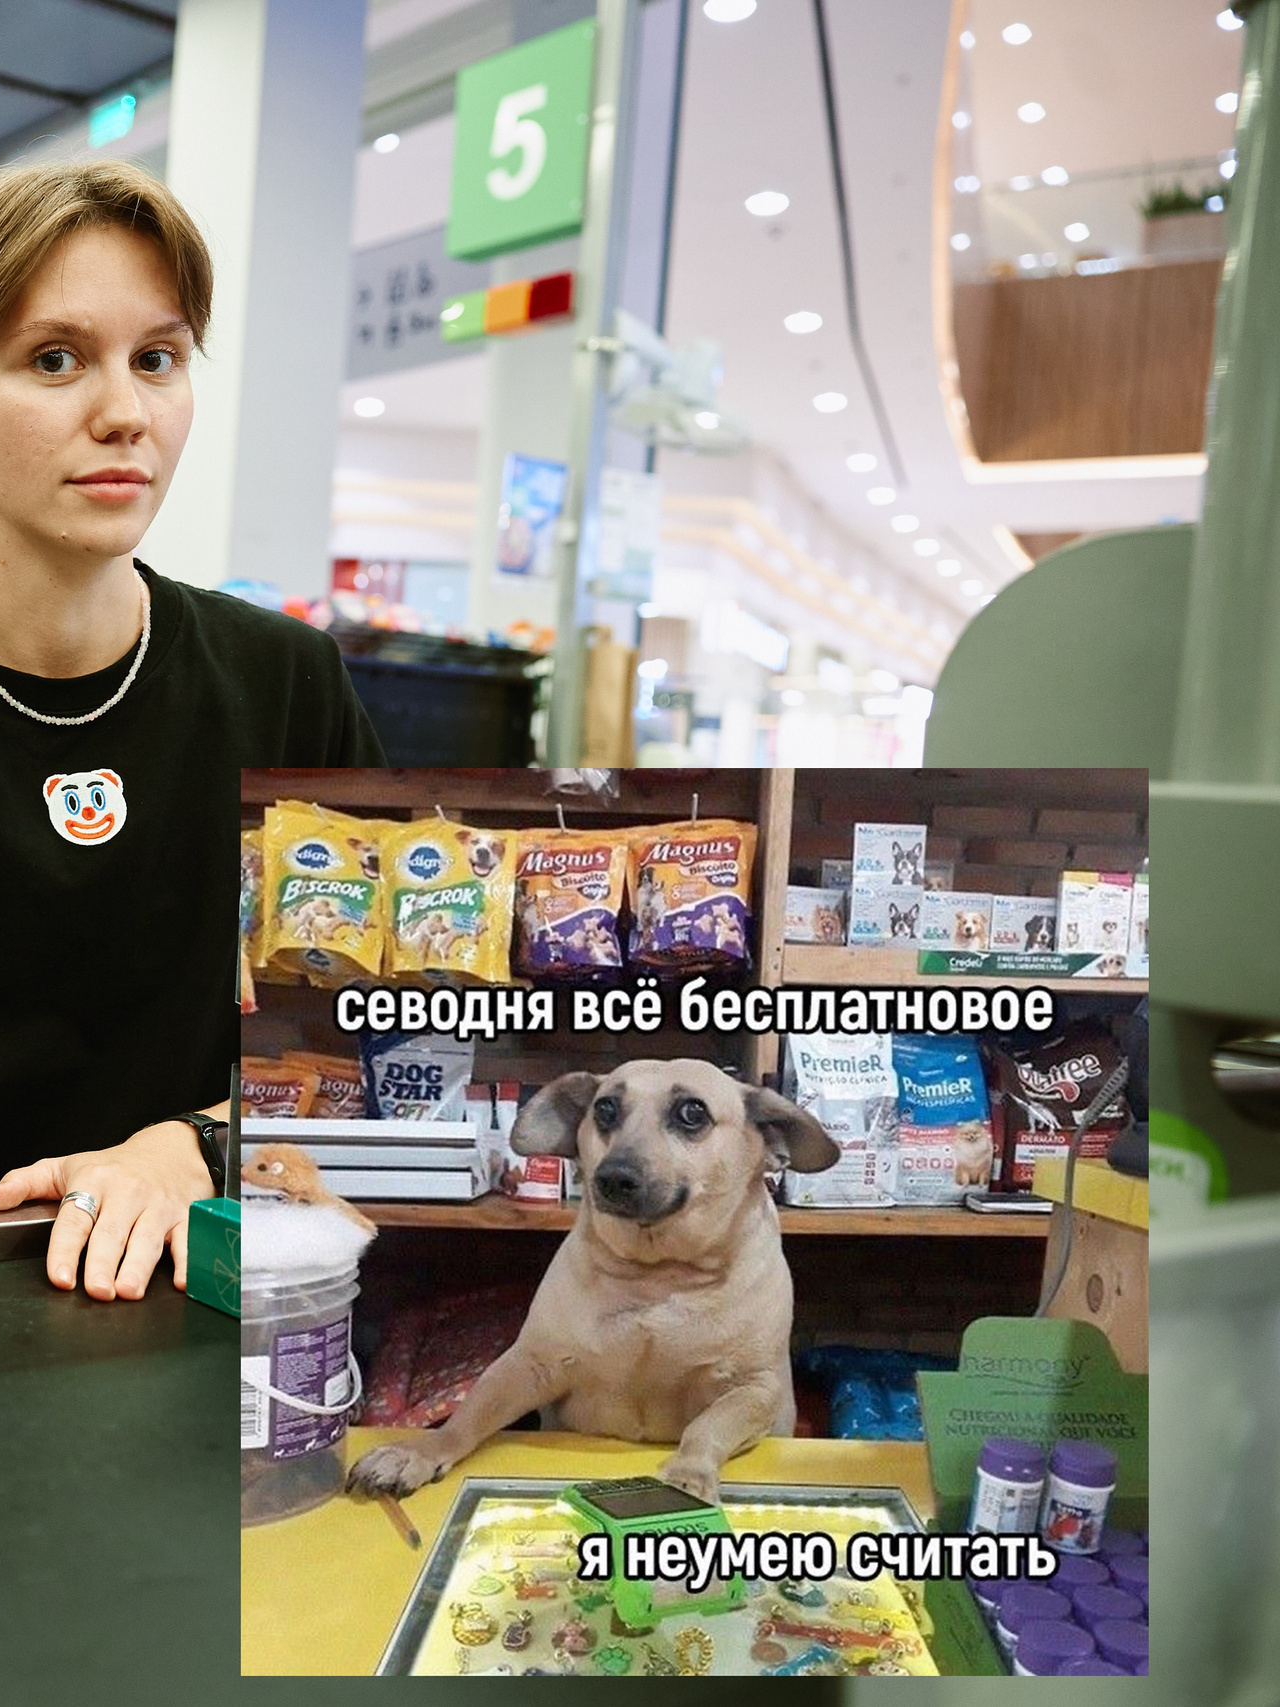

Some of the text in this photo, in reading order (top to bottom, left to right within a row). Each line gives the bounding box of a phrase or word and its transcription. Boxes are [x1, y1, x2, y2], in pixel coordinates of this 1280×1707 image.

[486, 82, 548, 201] 5
[515, 851, 606, 876] Magnus
[637, 842, 735, 867] Magnus
[385, 1062, 442, 1083] DOG
[379, 1080, 442, 1100] STAR
